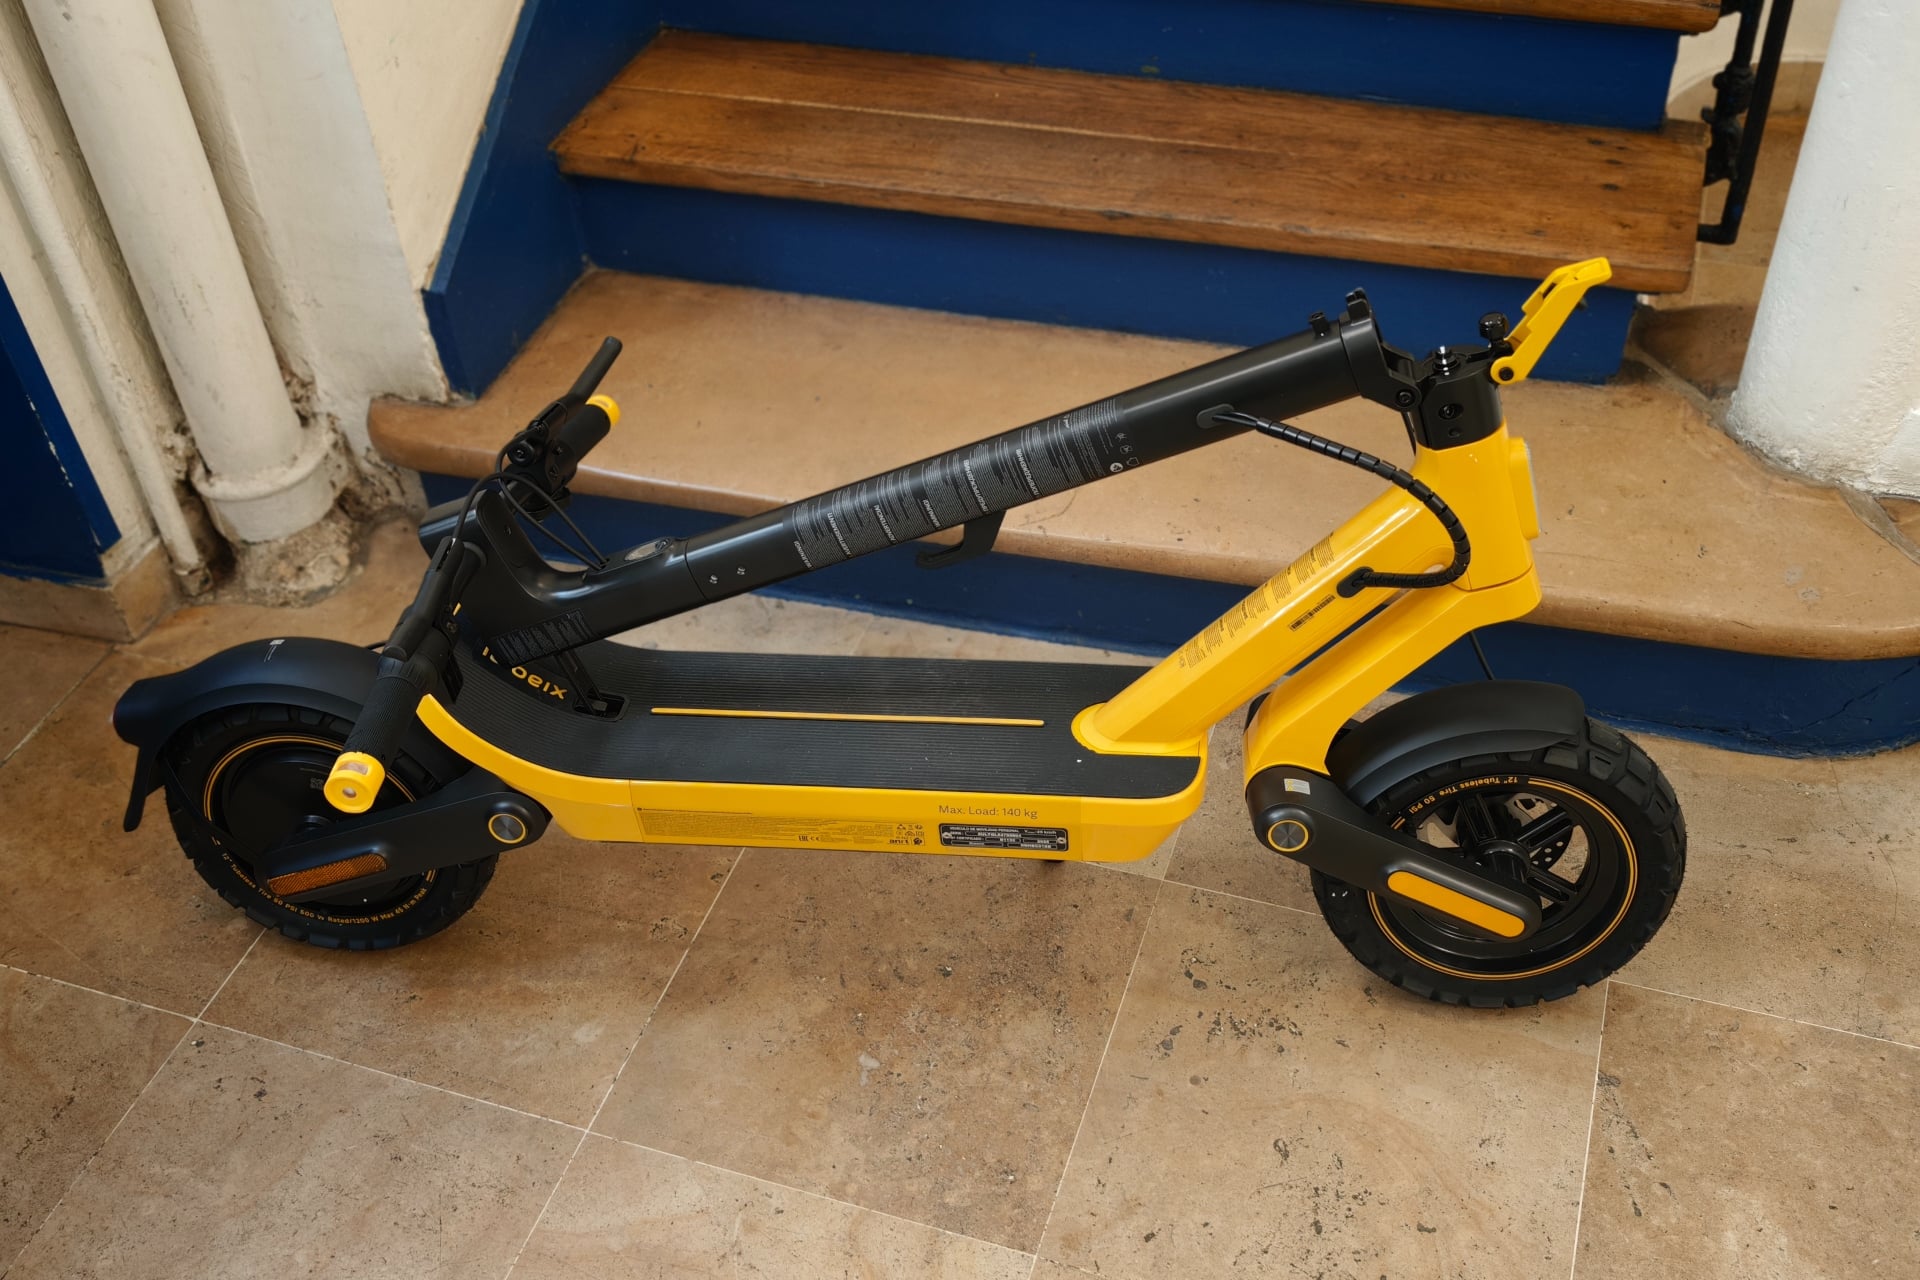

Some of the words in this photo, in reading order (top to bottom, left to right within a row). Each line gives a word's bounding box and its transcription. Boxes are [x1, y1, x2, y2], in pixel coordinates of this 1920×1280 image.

[482, 646, 568, 700] xiaoi
[1460, 777, 1500, 788] Tubeless
[1439, 786, 1458, 796] Tire
[1423, 795, 1436, 805] 50
[938, 805, 966, 815] Max.
[968, 806, 1000, 816] Load:
[1002, 807, 1021, 817] 140
[1024, 809, 1039, 819] kg
[1408, 803, 1423, 815] PSI
